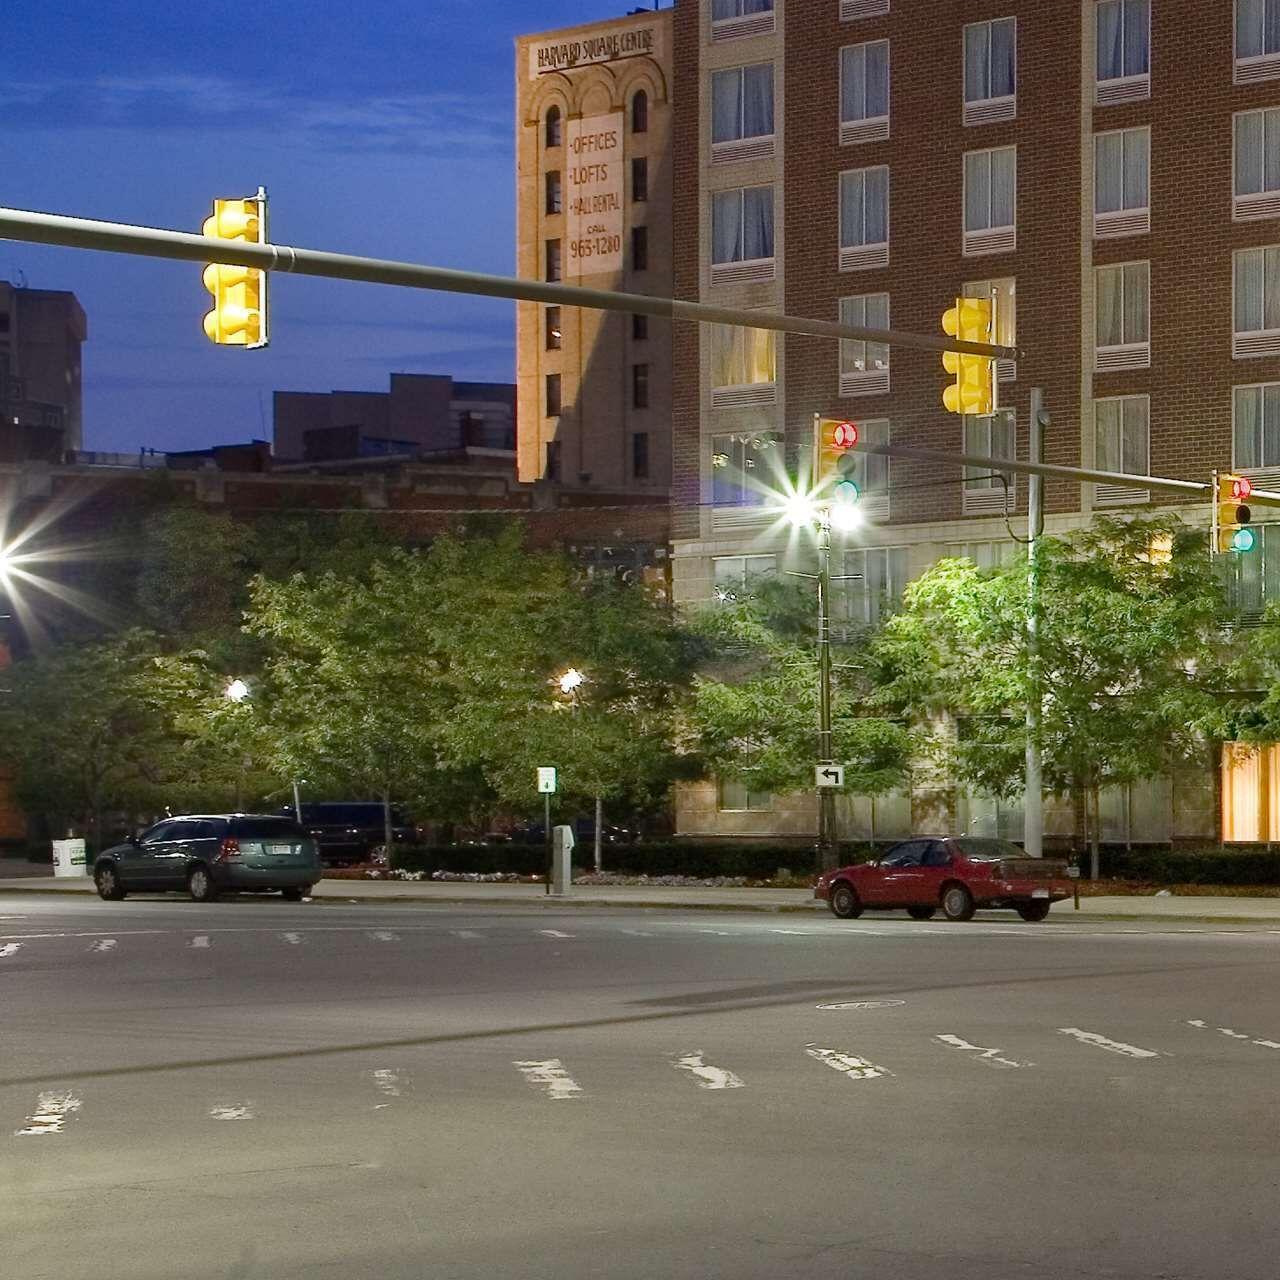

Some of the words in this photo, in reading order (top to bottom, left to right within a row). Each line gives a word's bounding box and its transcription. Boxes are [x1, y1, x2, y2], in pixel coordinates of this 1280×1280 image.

[538, 42, 581, 67] HARVARD
[583, 34, 620, 60] SQUARE
[573, 131, 617, 154] OFFICES
[573, 163, 608, 185] LOFTS
[587, 224, 607, 234] CALL
